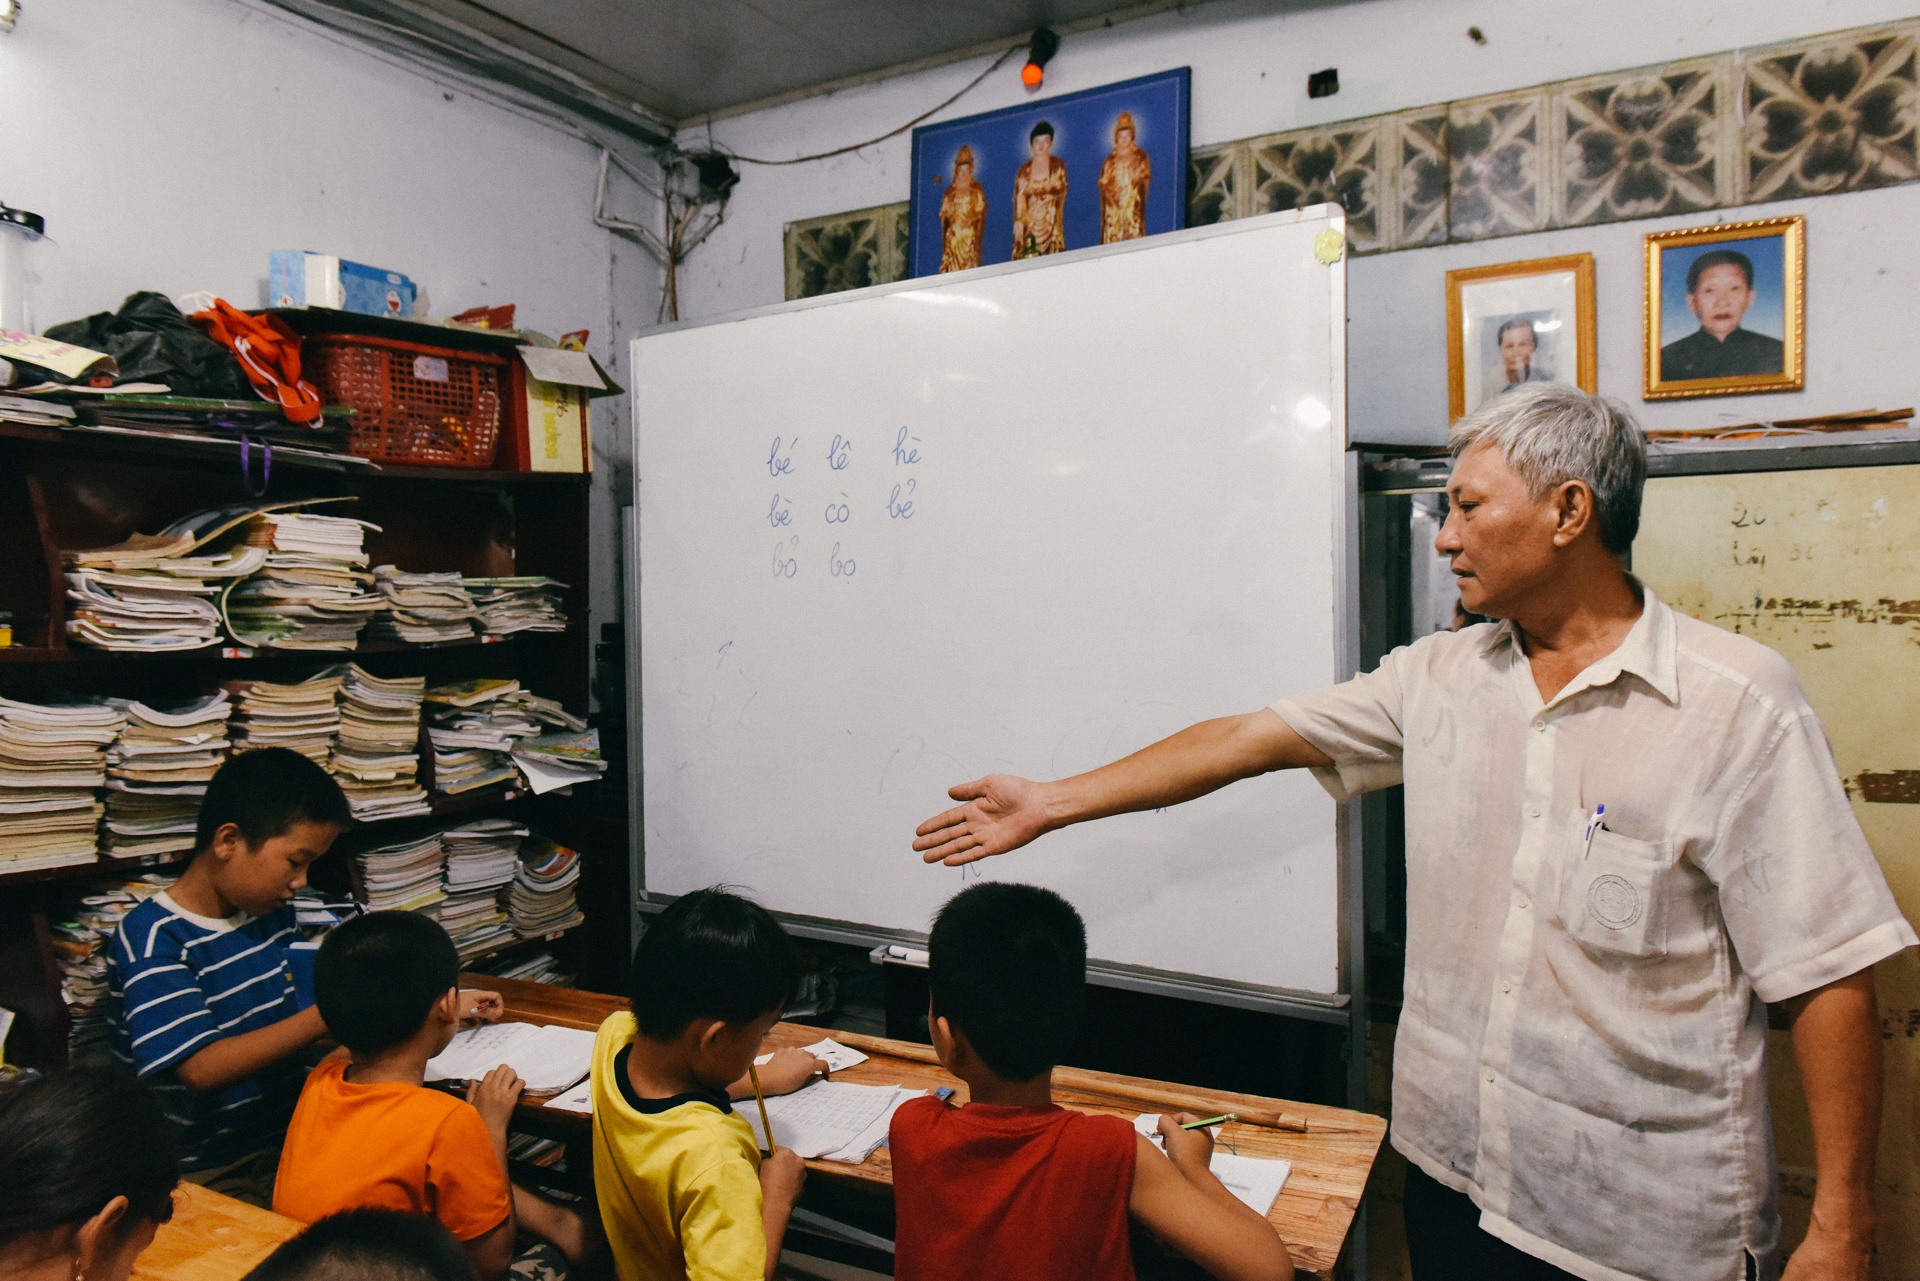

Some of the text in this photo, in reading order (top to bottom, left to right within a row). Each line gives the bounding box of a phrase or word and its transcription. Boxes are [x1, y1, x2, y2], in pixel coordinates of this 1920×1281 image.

[766, 425, 922, 477] bé lê hè
[766, 478, 917, 528] bè cò bẻ
[772, 534, 800, 579] bỏ
